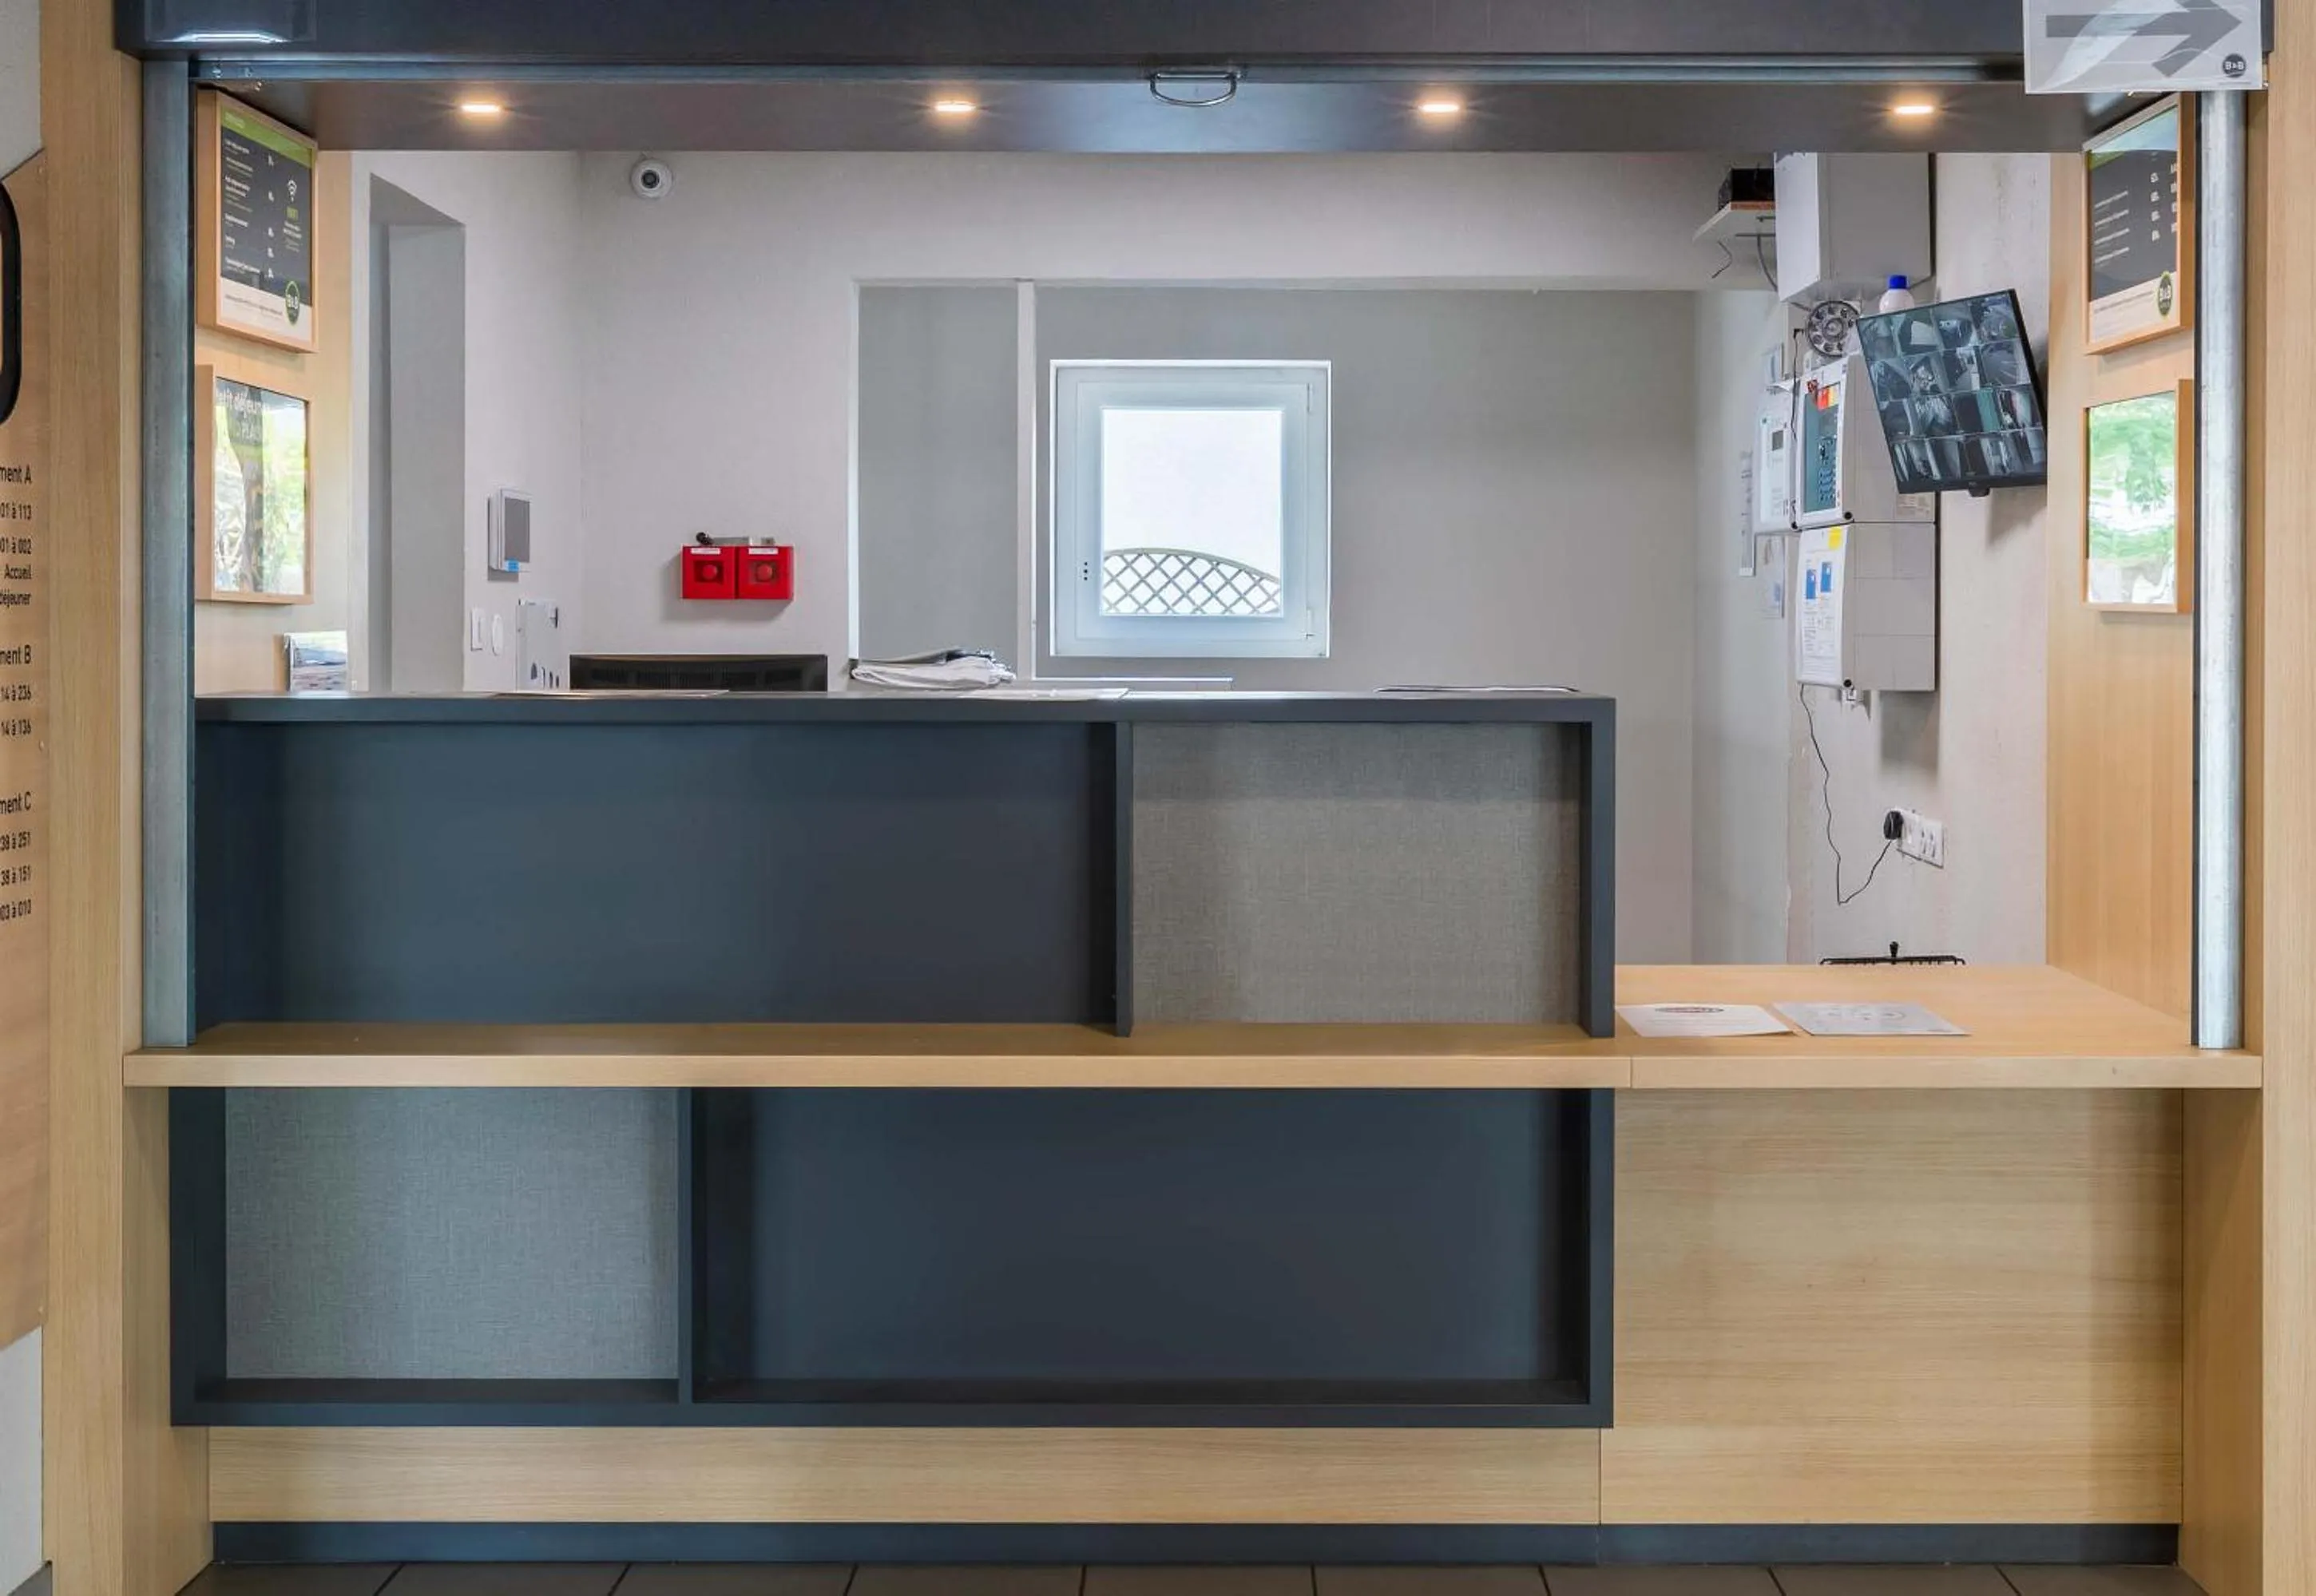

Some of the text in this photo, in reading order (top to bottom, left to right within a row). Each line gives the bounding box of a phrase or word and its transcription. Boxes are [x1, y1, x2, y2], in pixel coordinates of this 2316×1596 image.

[24, 464, 32, 484] A
[12, 501, 16, 518] à
[18, 503, 32, 520] 113
[11, 537, 16, 553] à
[18, 537, 32, 554] 002
[4, 564, 32, 579] Accueil
[24, 644, 32, 664] B
[11, 684, 16, 701] à
[18, 684, 32, 700] 236
[11, 719, 16, 735] à
[18, 719, 32, 735] 136
[24, 790, 32, 810] C
[11, 832, 16, 849] à
[18, 830, 32, 848] 251
[11, 867, 16, 883] à
[18, 865, 31, 883] 151
[11, 901, 16, 918] à
[18, 898, 32, 917] 010
